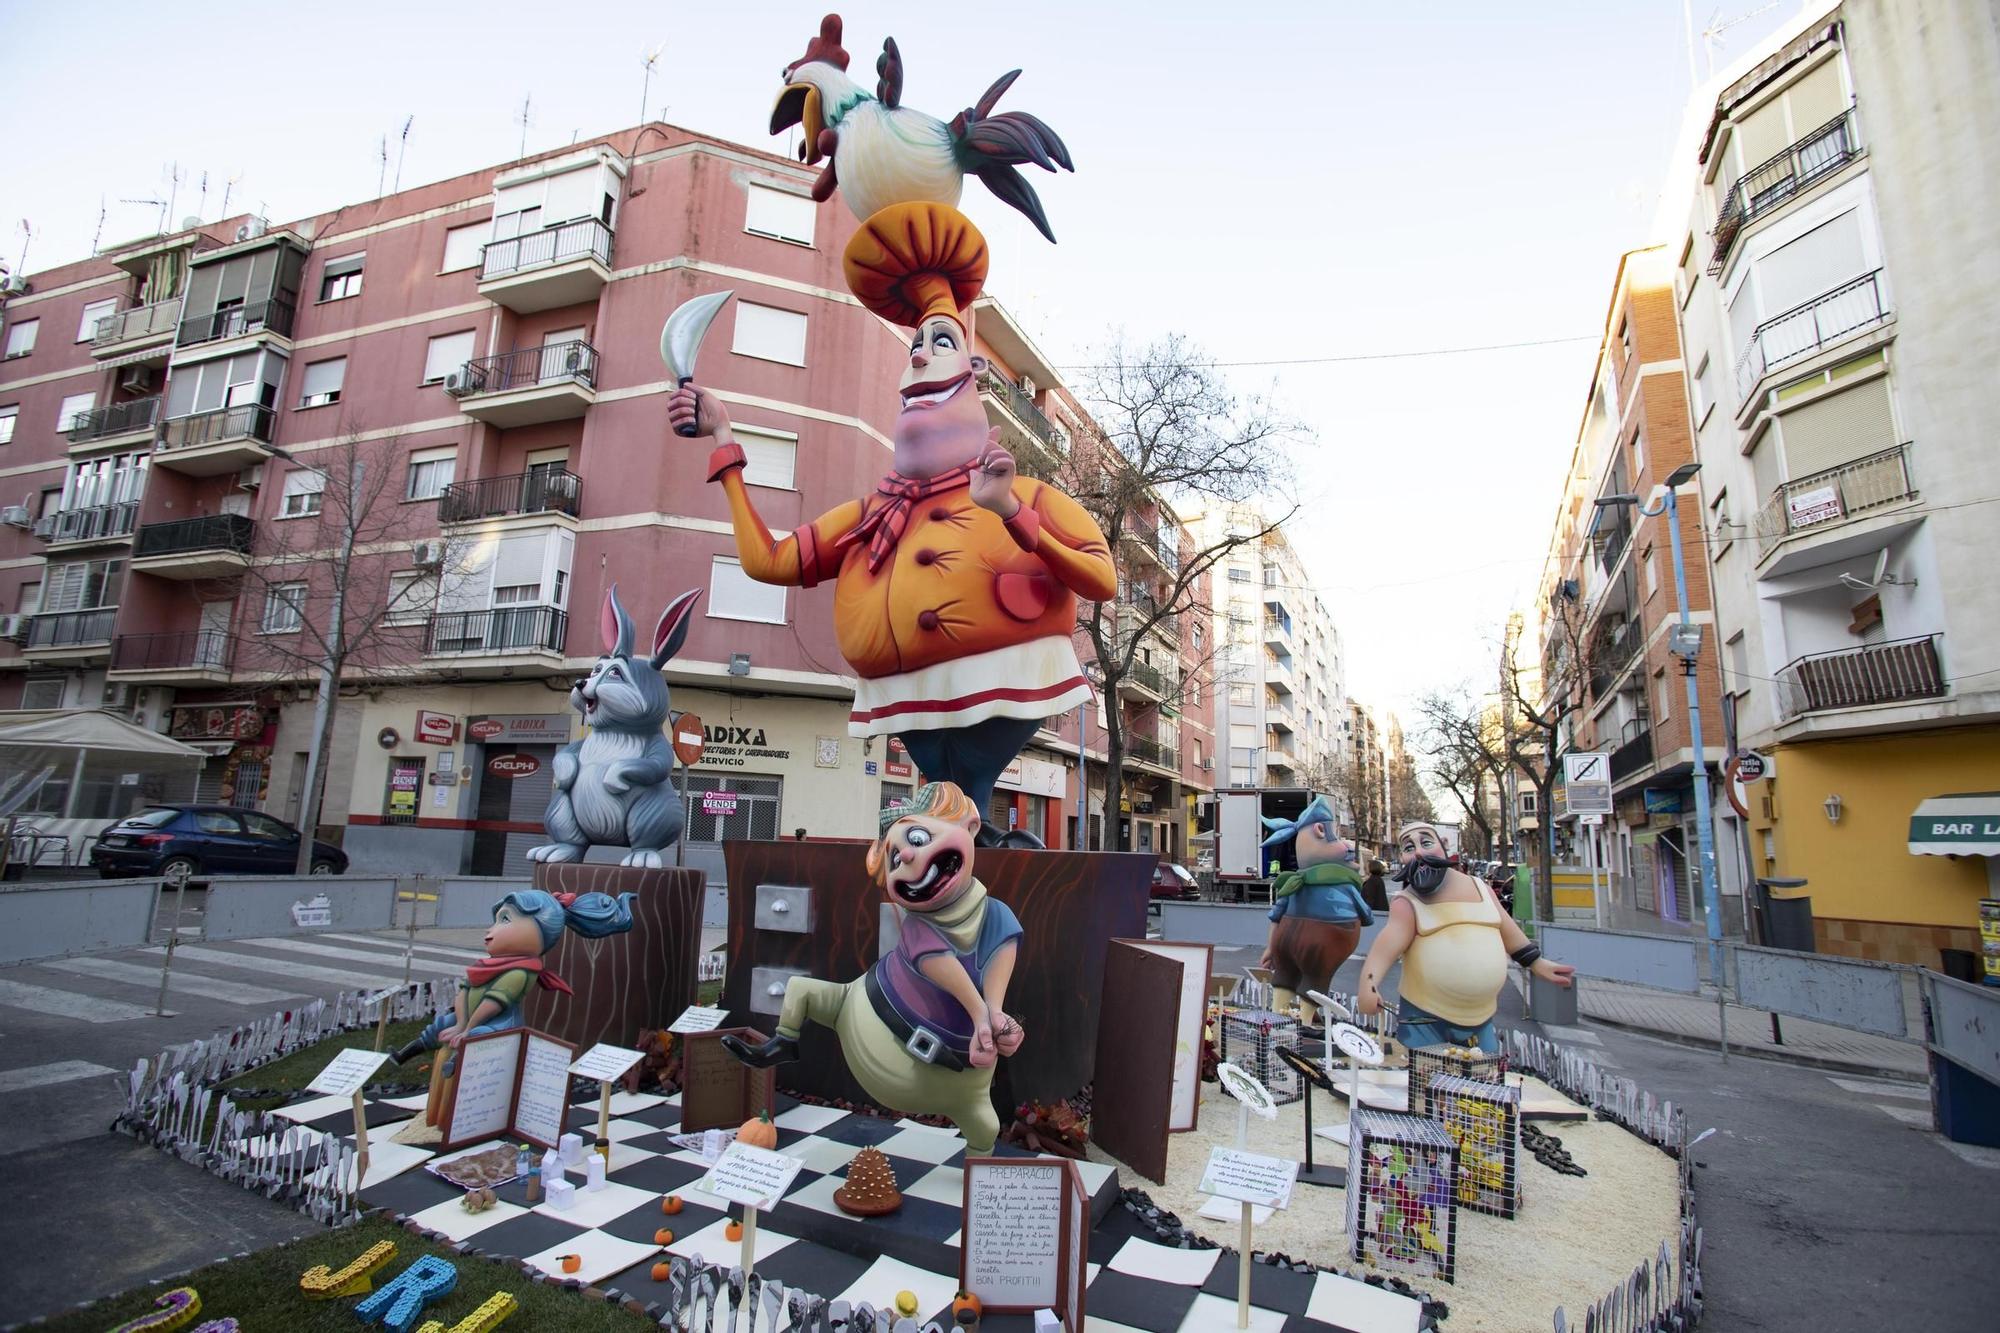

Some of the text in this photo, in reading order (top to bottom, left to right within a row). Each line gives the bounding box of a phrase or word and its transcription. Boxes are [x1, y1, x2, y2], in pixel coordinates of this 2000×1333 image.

[1792, 501, 1837, 519] DISPONIBLE
[425, 720, 450, 728] DELPHI
[510, 719, 546, 730] LADIXA
[472, 725, 502, 733] DELPHI
[424, 735, 448, 744] SERVICE
[704, 725, 767, 746] ADiXA
[494, 762, 535, 770] DELPHI
[699, 757, 744, 766] SERVICIO
[890, 765, 908, 774] SERVICE
[705, 800, 735, 808] VENDE
[1931, 823, 1974, 835] BAR
[975, 1275, 994, 1285] BON
